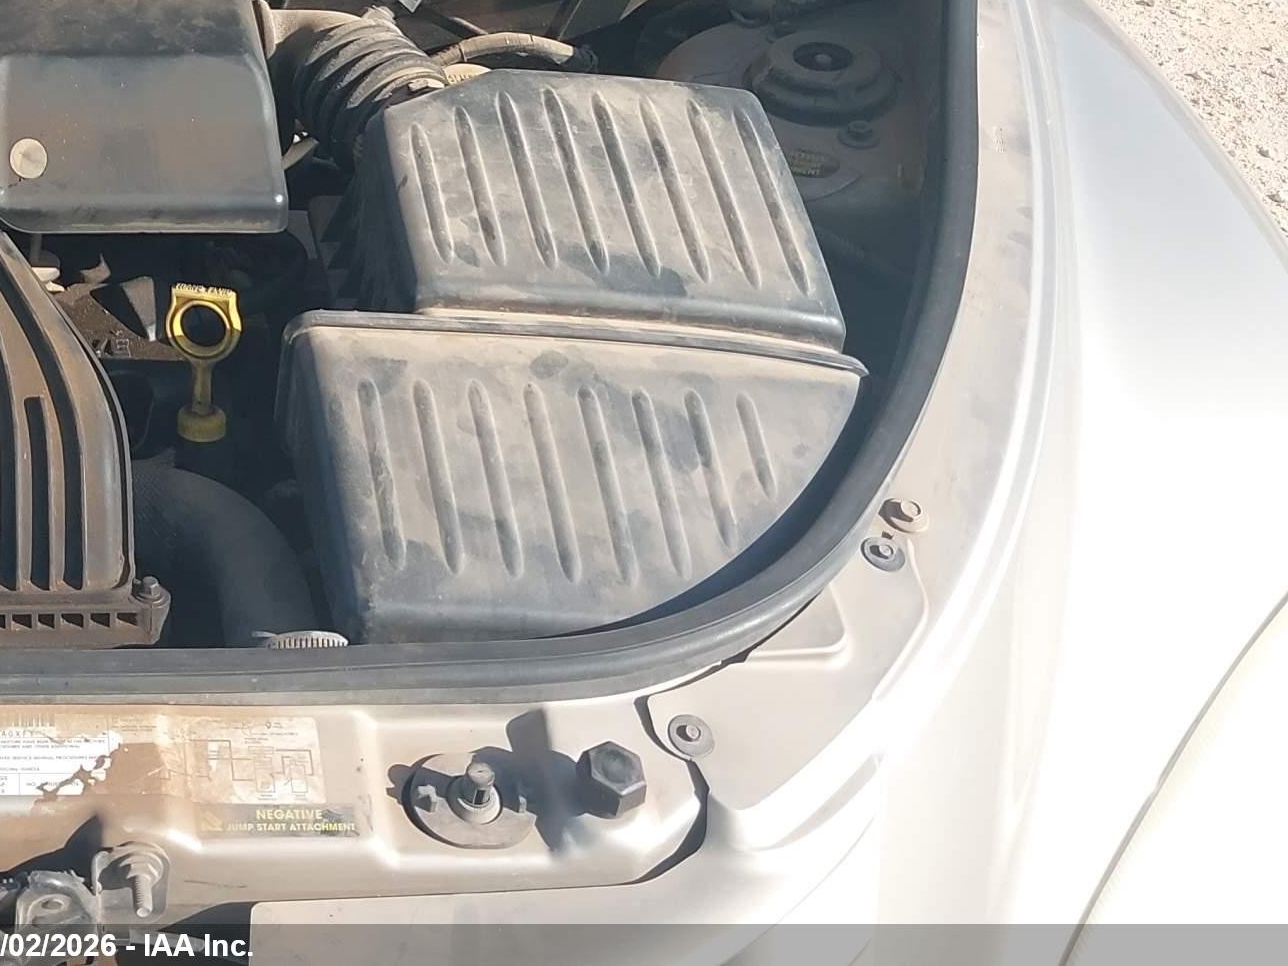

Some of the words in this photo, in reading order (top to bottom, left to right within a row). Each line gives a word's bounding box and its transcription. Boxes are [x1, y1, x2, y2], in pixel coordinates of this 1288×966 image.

[255, 809, 323, 820] NEGATIVE
[227, 822, 254, 832] JUMP
[256, 822, 286, 832] START
[289, 822, 356, 832] ATTACHMENT
